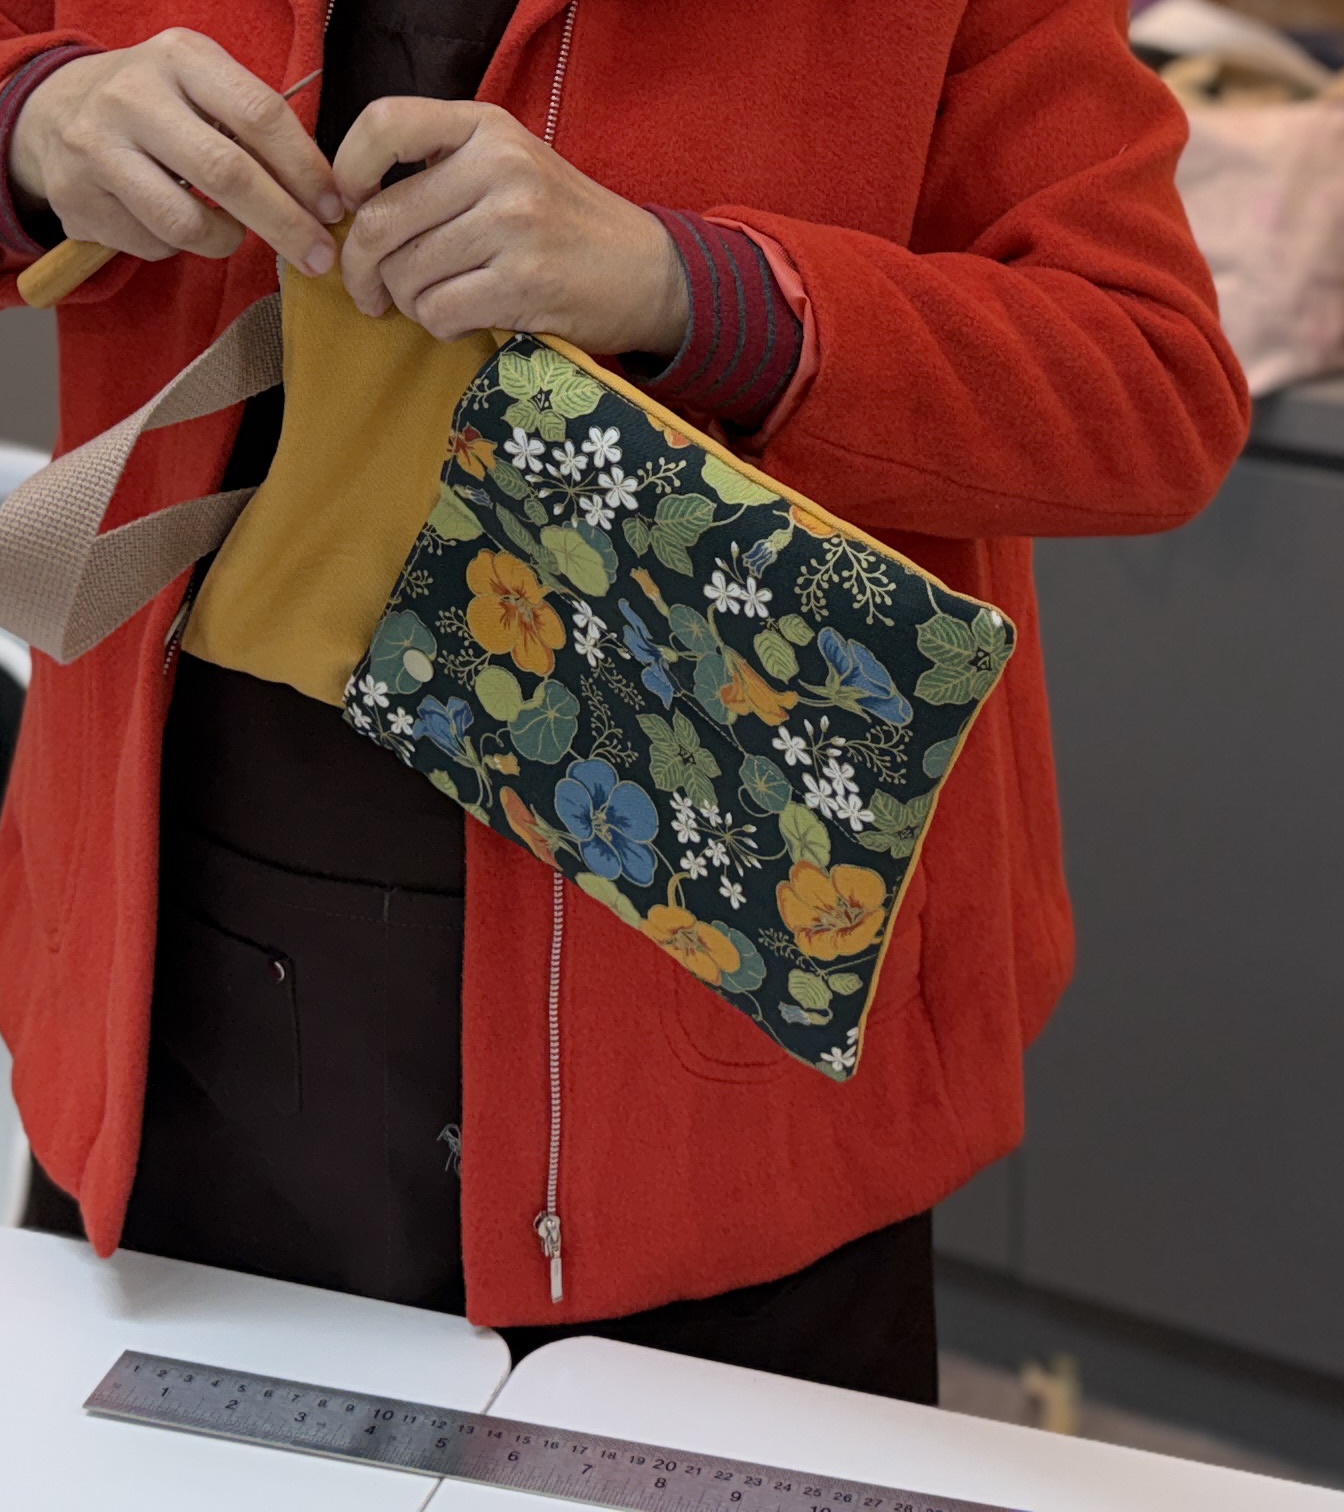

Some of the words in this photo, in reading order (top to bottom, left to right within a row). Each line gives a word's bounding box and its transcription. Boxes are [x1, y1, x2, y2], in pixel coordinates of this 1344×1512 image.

[161, 1387, 169, 1397] 1
[225, 1398, 238, 1410] 2
[294, 1411, 307, 1423] 3
[364, 1425, 376, 1435] 4
[435, 1437, 448, 1449] 5
[508, 1450, 521, 1462] 6
[581, 1463, 593, 1475] 7
[654, 1477, 667, 1489] 8
[729, 1491, 742, 1502] 9
[373, 1407, 394, 1421] 10
[402, 1414, 417, 1424] 11
[430, 1419, 447, 1430] 12
[458, 1424, 475, 1435] 13
[487, 1429, 503, 1440] 14
[515, 1434, 532, 1445] 15
[543, 1439, 559, 1450] 16
[571, 1444, 588, 1455] 17
[600, 1450, 617, 1461] 18
[629, 1455, 646, 1466] 19
[652, 1458, 677, 1472] 20
[685, 1465, 702, 1476] 21
[714, 1470, 733, 1481] 22
[743, 1475, 763, 1487] 23
[773, 1481, 792, 1492] 24
[802, 1486, 822, 1497] 25
[833, 1491, 853, 1503] 26
[863, 1497, 883, 1508] 27
